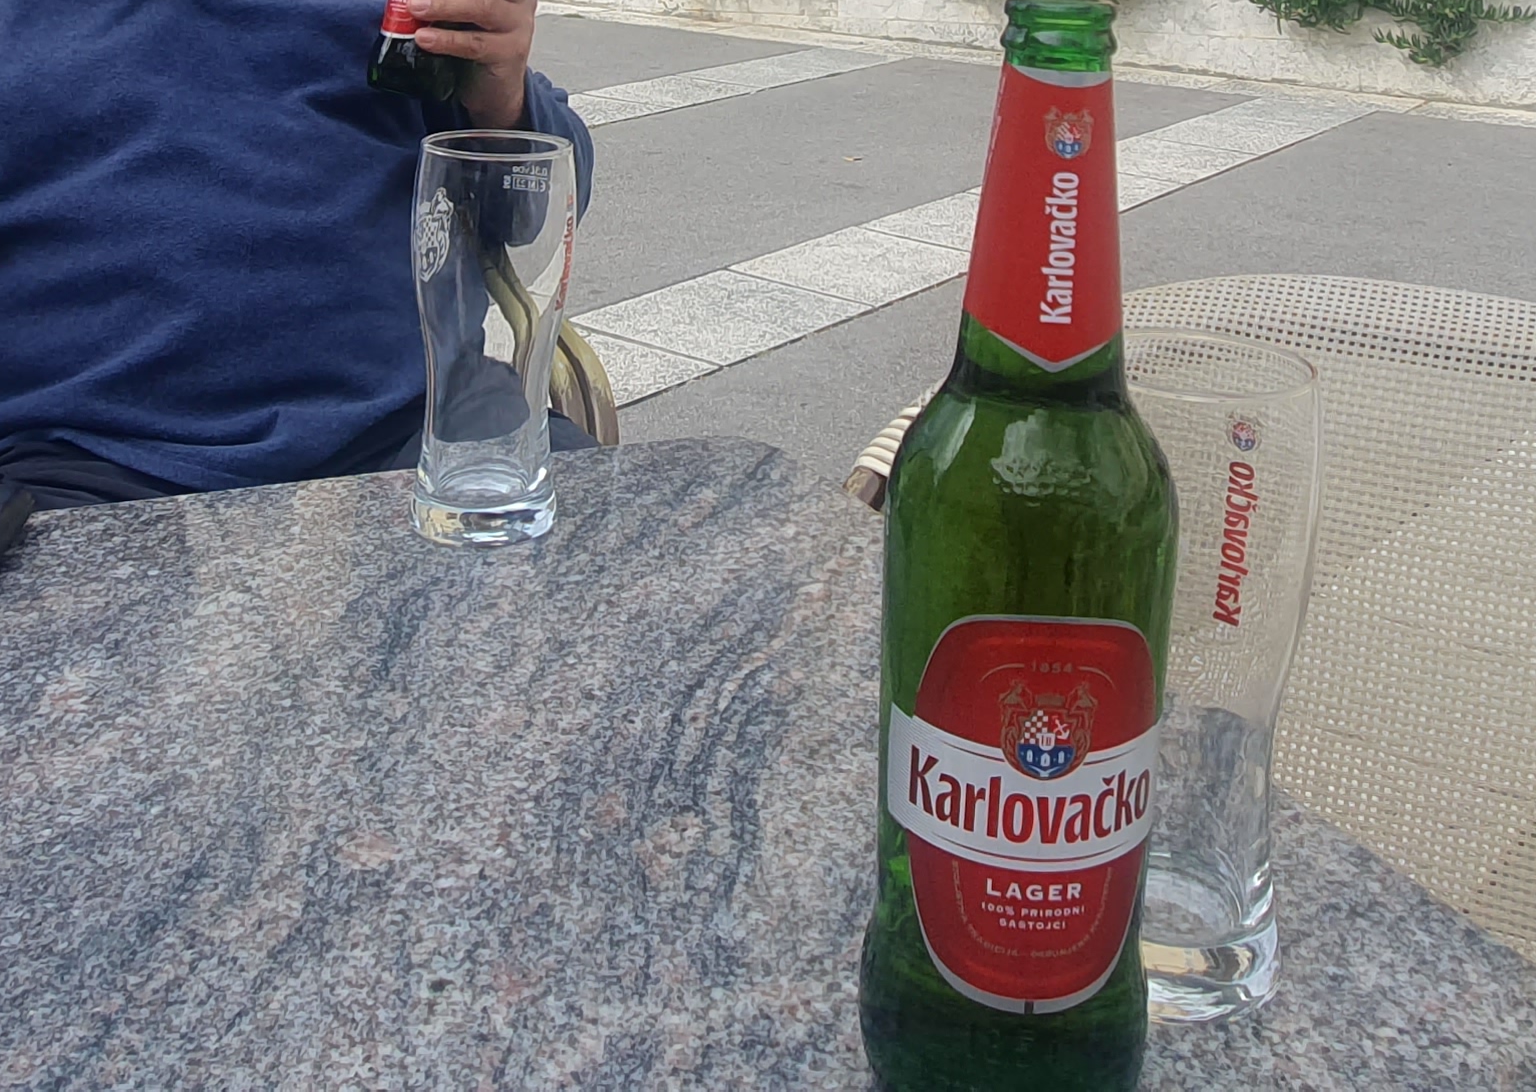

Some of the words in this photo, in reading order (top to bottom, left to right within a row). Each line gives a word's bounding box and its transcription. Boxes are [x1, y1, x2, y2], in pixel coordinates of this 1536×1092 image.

[1039, 172, 1079, 324] Karlovačko
[1030, 660, 1074, 673] 1854
[909, 744, 1150, 844] Karlovačko
[986, 877, 1082, 901] LAGER
[981, 901, 1015, 916] 100%
[1020, 905, 1085, 918] PRIRODNI
[999, 917, 1066, 931] SASTOJCI
